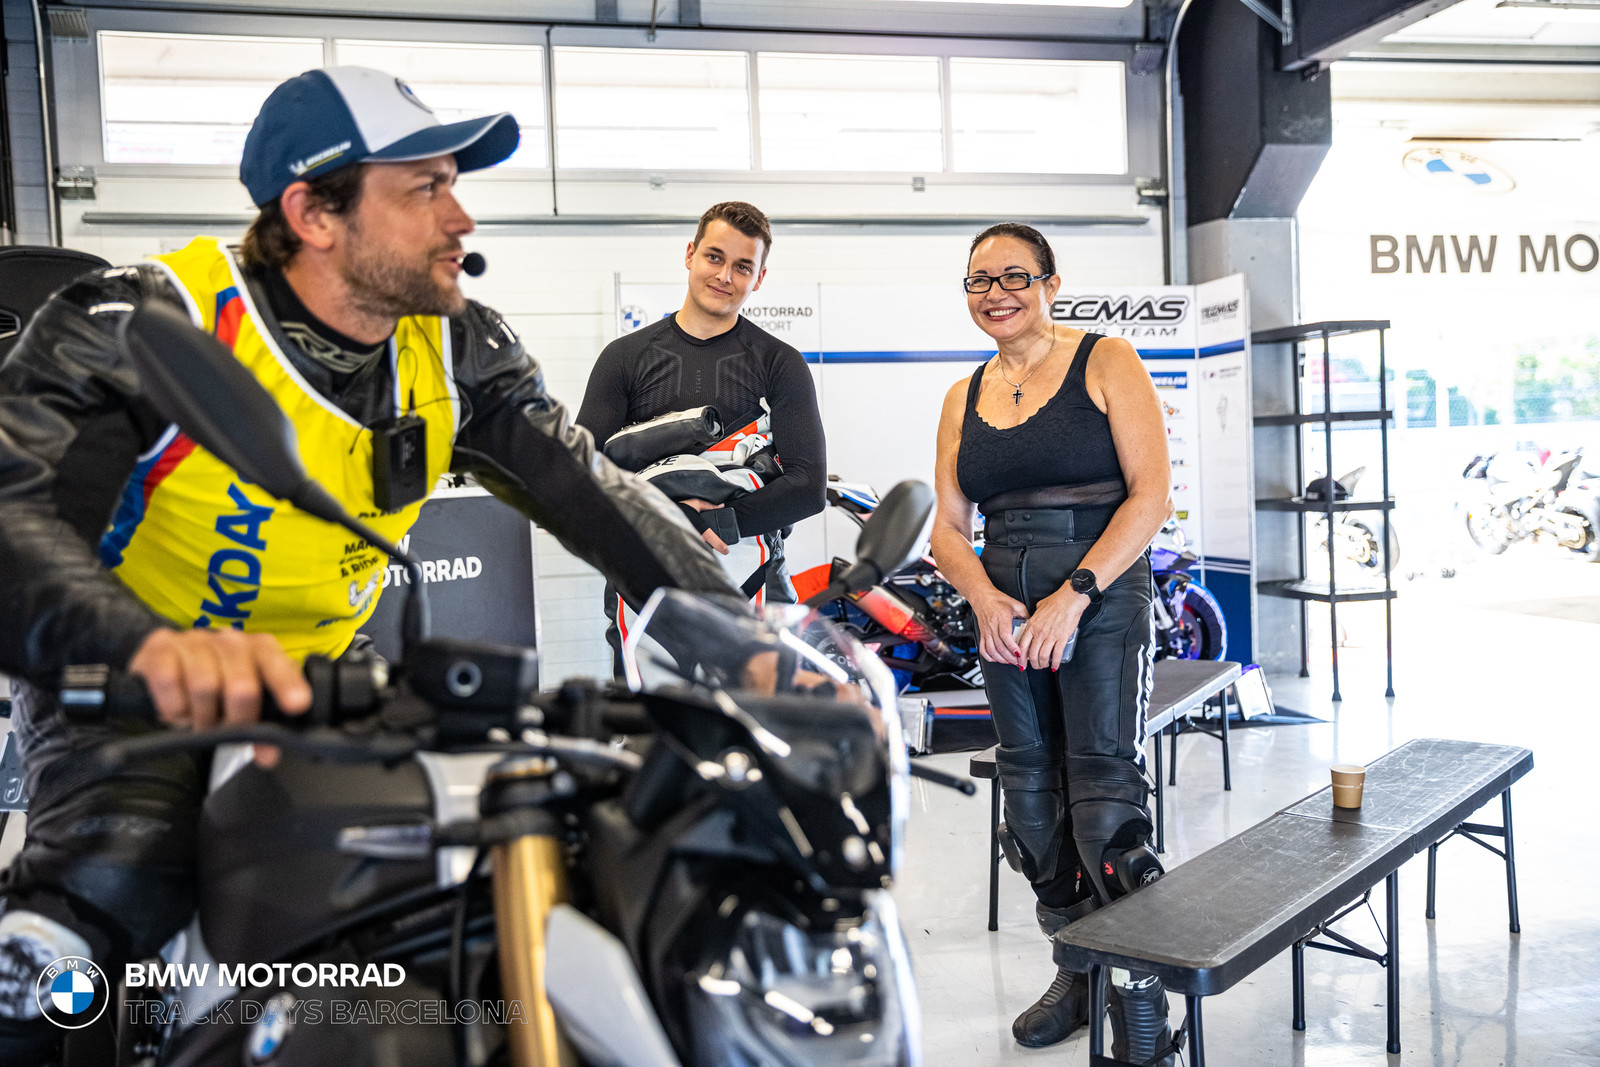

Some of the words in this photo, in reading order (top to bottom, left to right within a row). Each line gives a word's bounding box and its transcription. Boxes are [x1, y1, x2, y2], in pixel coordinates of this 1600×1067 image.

[1370, 234, 1498, 273] BMW
[1519, 233, 1600, 273] MO
[741, 307, 814, 318] MOTORRAD
[1050, 300, 1186, 321] ECMAS
[1120, 327, 1178, 337] TEAM
[382, 556, 483, 589] OTORRAD
